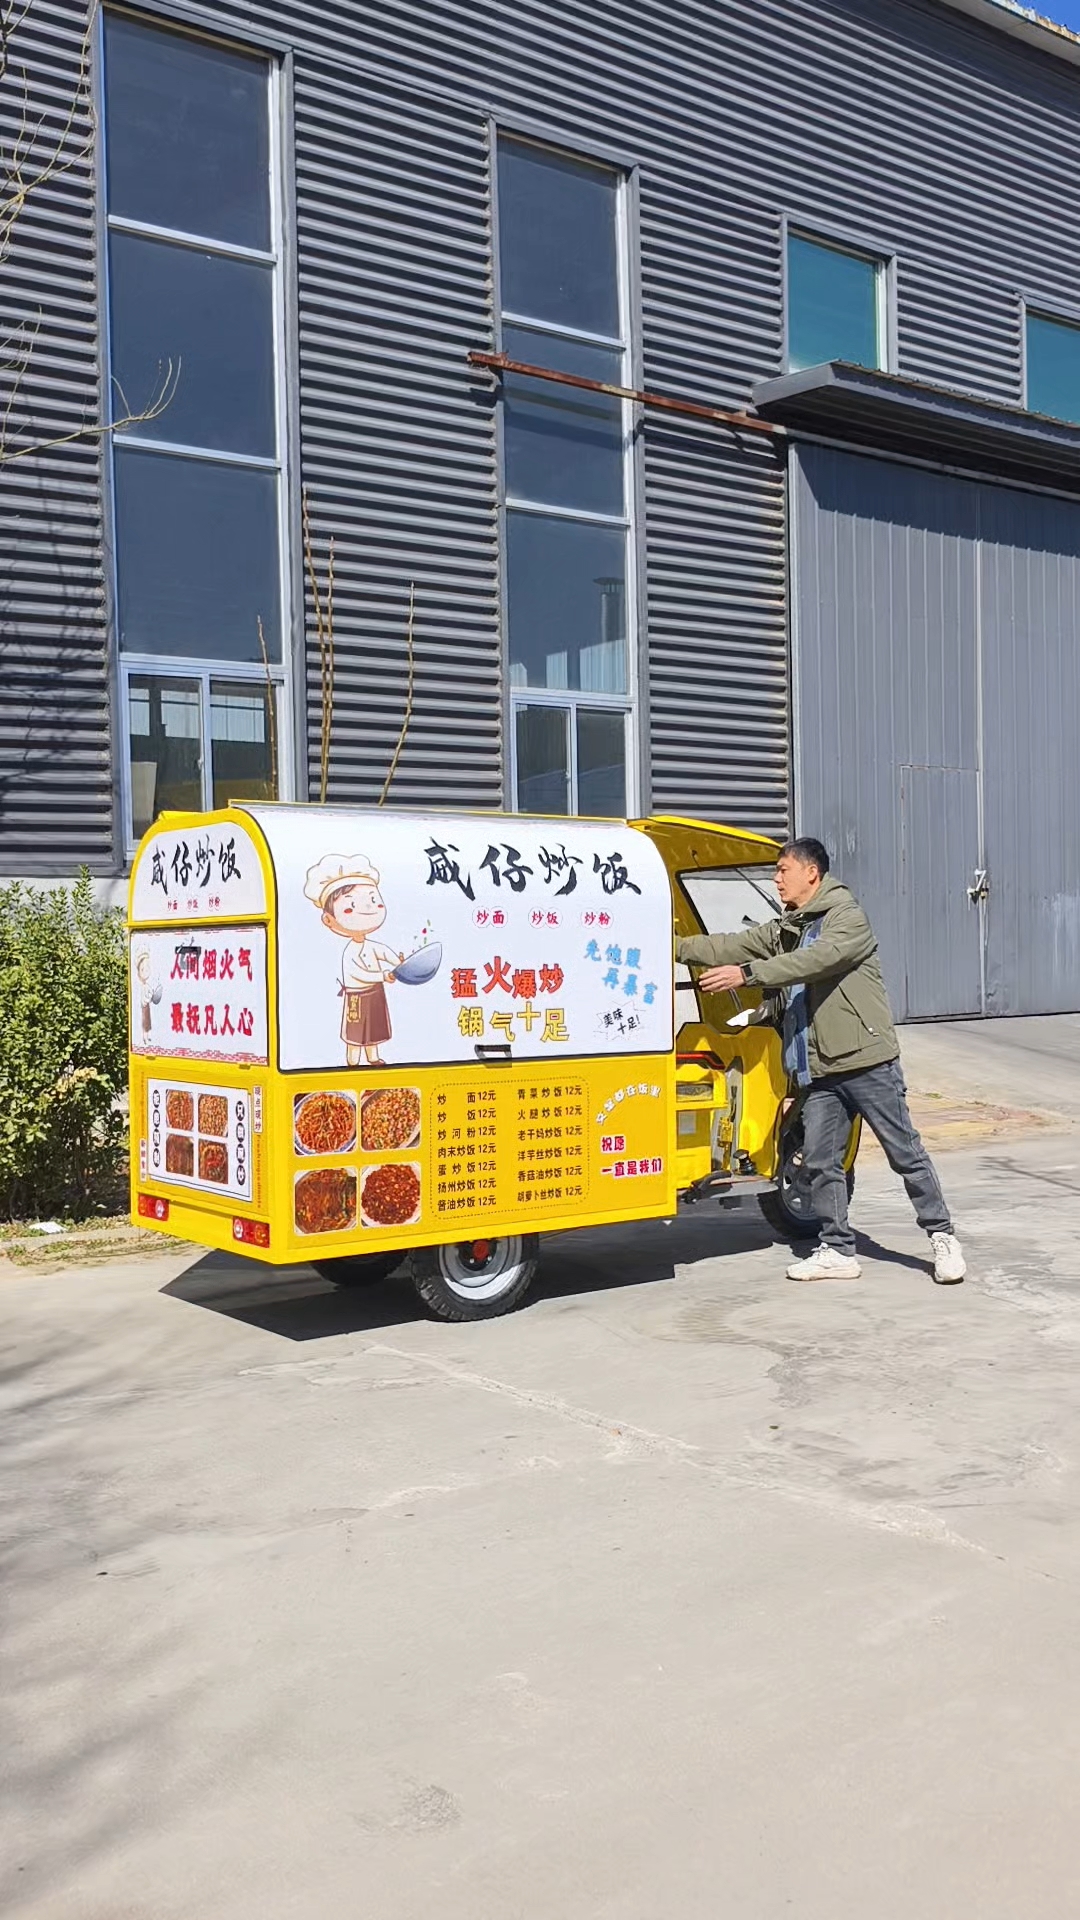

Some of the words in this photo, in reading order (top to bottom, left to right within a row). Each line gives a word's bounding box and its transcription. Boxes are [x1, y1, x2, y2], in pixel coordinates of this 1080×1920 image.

[476, 910, 505, 925] 炒面
[531, 910, 559, 925] 炒饭
[584, 911, 611, 926] 炒粉
[170, 946, 253, 982] 人间烟火气
[451, 956, 565, 999] 猛火爆炒
[171, 1001, 254, 1036] 最抚凡人心
[457, 1001, 570, 1042] 锅气十足
[603, 1008, 623, 1028] 美味
[478, 1090, 496, 1101] 12元
[565, 1084, 582, 1095] 12元
[478, 1107, 496, 1118] 12元
[565, 1104, 582, 1116] 12元
[478, 1125, 496, 1136] 12元
[565, 1125, 582, 1136] 12元
[478, 1142, 496, 1154] 12元
[602, 1136, 624, 1151] 祝愿
[565, 1145, 582, 1156] 12元
[478, 1160, 496, 1171] 12元
[565, 1165, 582, 1176] 12元
[602, 1158, 662, 1176] 一直是我们
[478, 1177, 496, 1189] 12元
[565, 1185, 582, 1196] 12元
[478, 1194, 496, 1206] 12元
